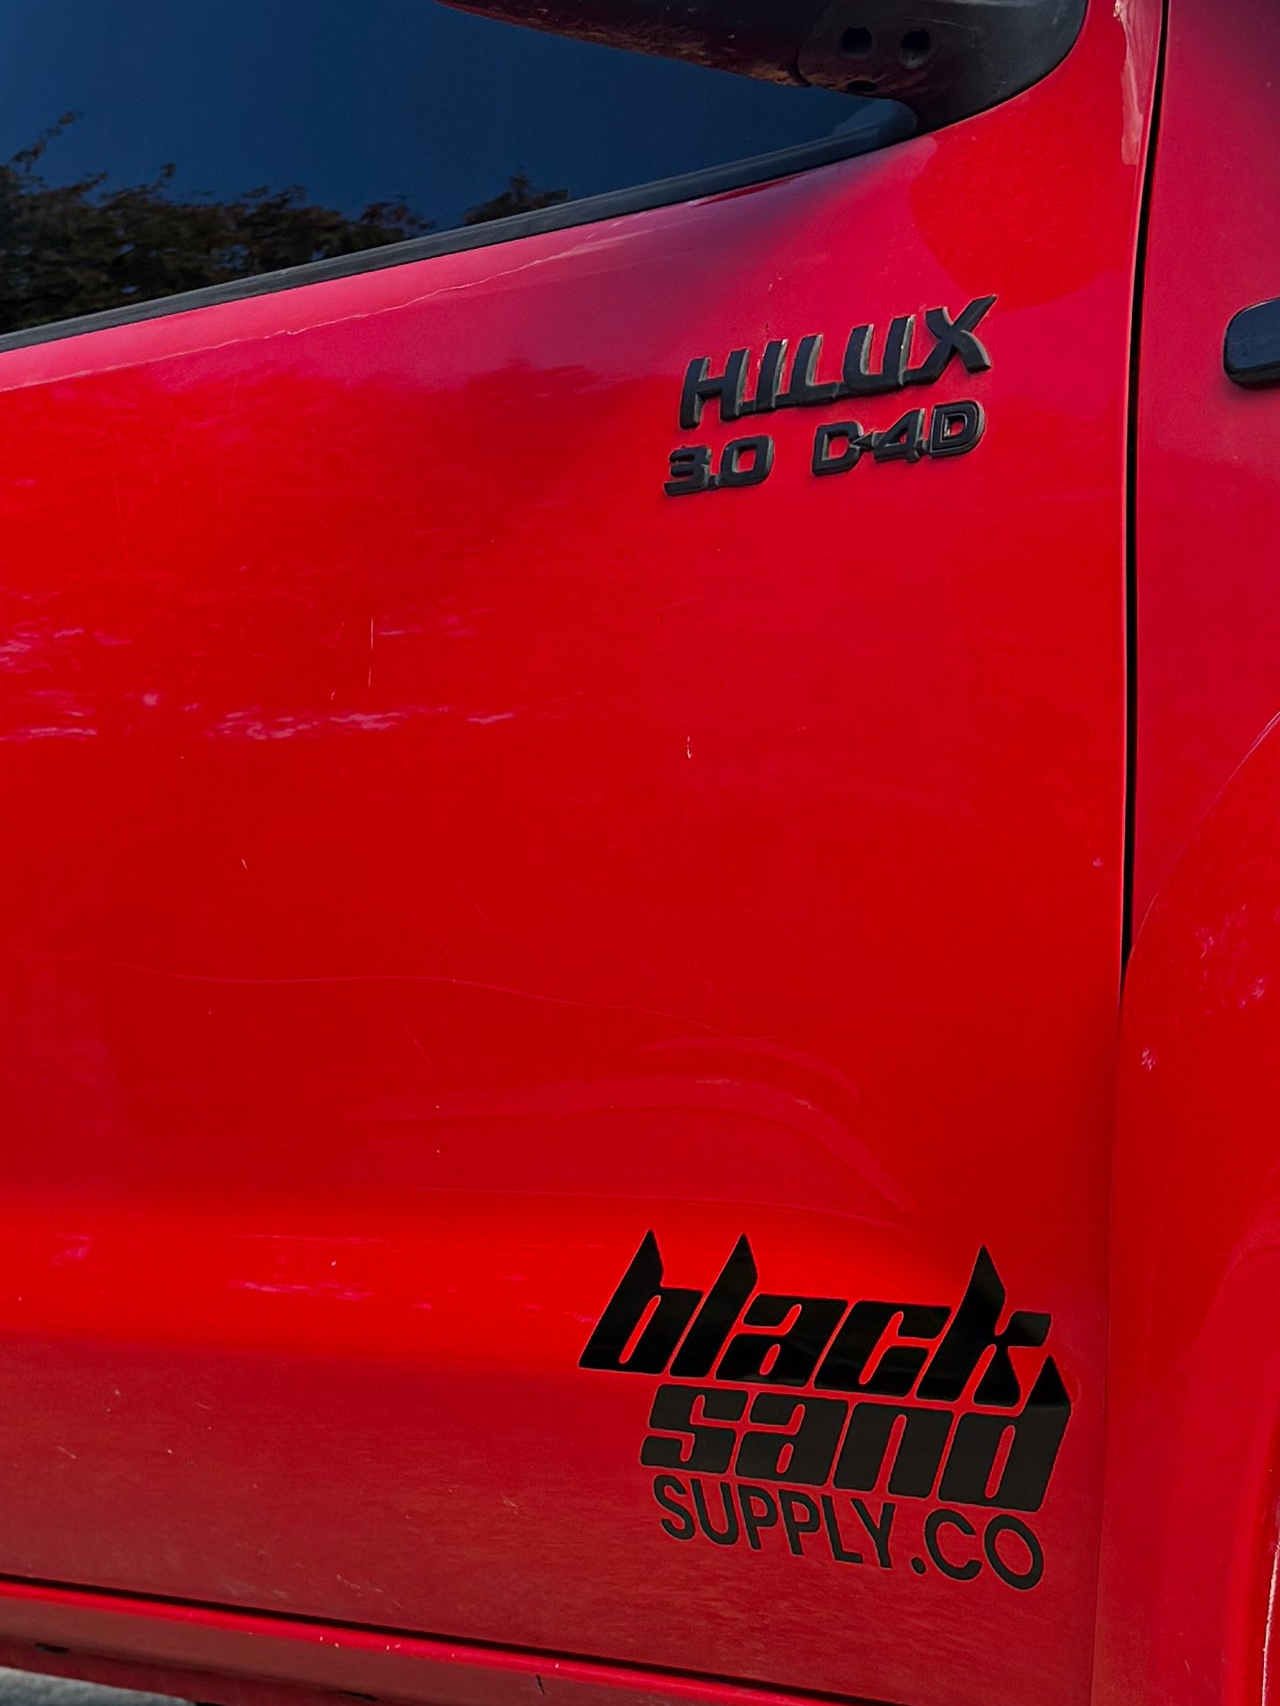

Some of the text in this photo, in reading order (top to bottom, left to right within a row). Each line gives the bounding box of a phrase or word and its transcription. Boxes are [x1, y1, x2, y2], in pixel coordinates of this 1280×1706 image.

[678, 294, 998, 430] HILUX
[578, 1228, 1052, 1408] black
[640, 1354, 1072, 1513] sand
[653, 1474, 1045, 1591] SUPPLY.CO
